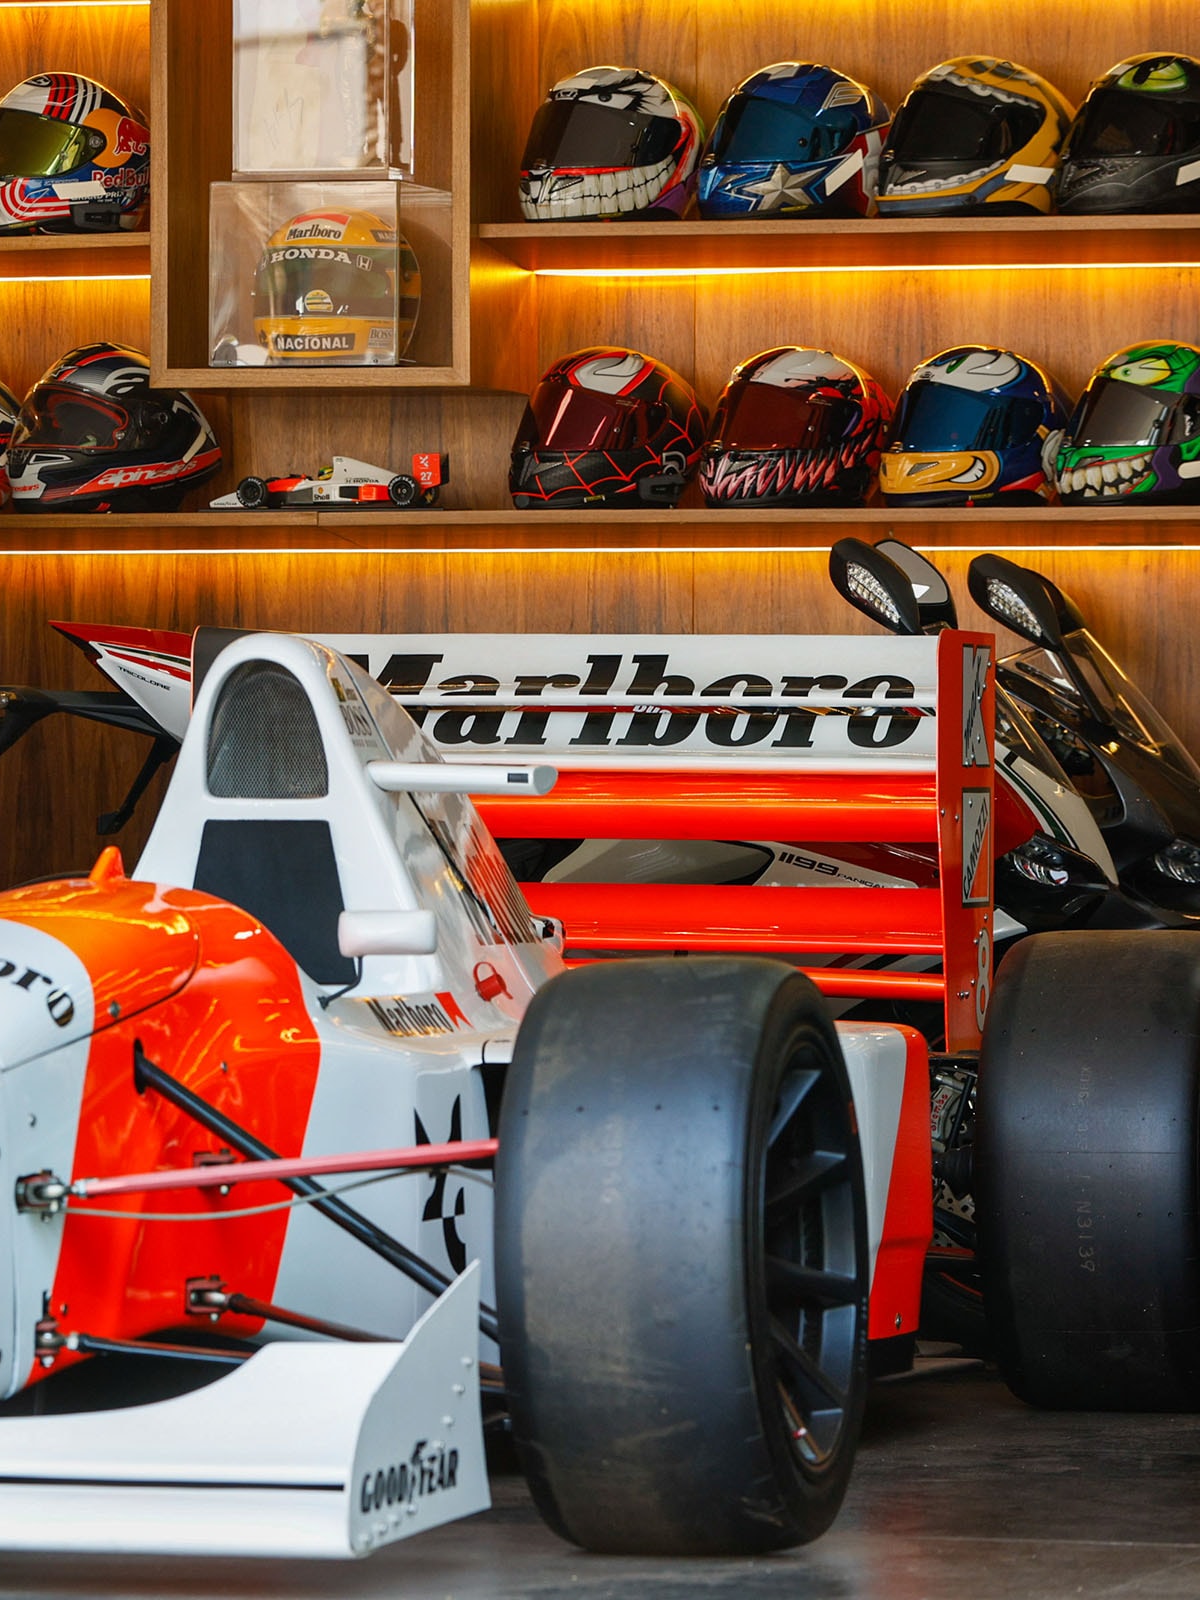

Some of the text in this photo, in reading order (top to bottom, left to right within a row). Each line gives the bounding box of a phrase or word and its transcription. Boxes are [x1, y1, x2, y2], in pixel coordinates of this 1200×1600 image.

[92, 167, 124, 188] Red
[288, 223, 342, 240] Marlboro
[270, 248, 352, 265] HONDA
[277, 337, 349, 350] NACIONAL
[420, 471, 433, 481] 27
[313, 493, 331, 501] Shell
[117, 665, 172, 692] TRICOLORE
[961, 797, 990, 901] CAMOZZI
[778, 851, 840, 877] 1199
[363, 996, 455, 1037] Marlboro
[360, 1438, 459, 1514] GOODYEAR
